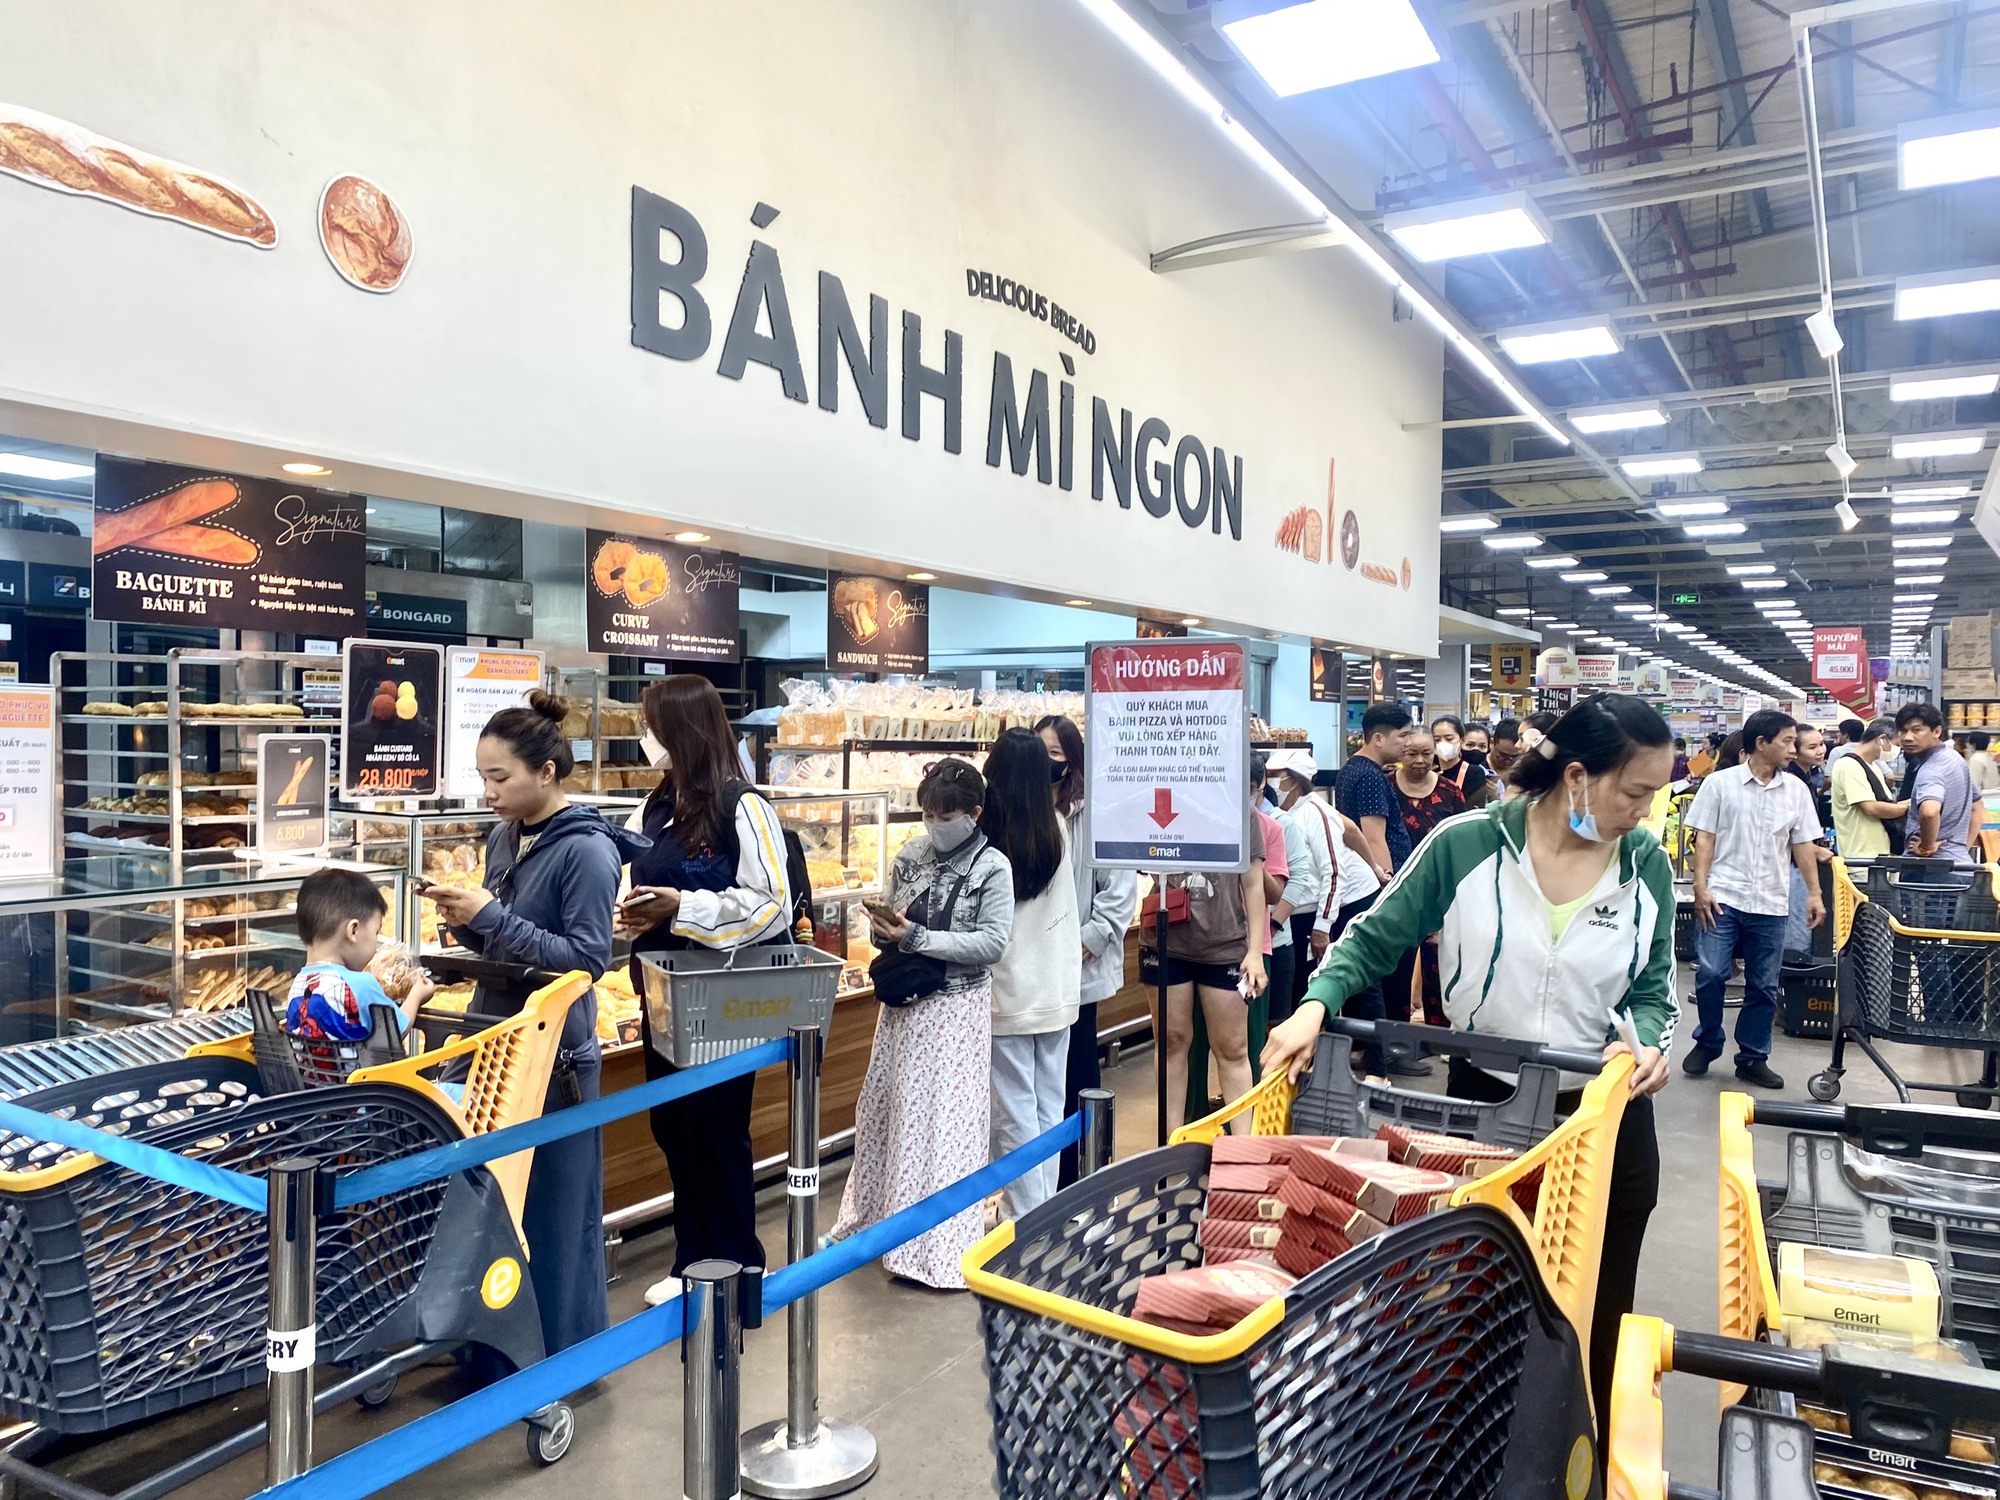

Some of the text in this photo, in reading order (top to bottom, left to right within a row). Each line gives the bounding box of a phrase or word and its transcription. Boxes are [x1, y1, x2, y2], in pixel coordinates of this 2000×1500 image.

[967, 268, 1096, 355] DELICIOUS BREAD
[631, 184, 1243, 542] BÁNH MÌ NGON
[274, 494, 366, 545] Signature
[683, 553, 739, 593] Signature
[115, 570, 234, 599] BAGUETTE
[328, 580, 343, 590] bánh
[142, 595, 207, 614] BÁNH MÌ
[887, 590, 929, 628] Signature
[383, 609, 452, 624] BONGARD
[612, 612, 650, 629] CURVE
[602, 630, 660, 648] CROISSANT
[1816, 632, 1858, 642] KHUYẾN
[386, 656, 405, 666] emart
[455, 655, 476, 663] emart
[837, 652, 878, 665] SANDWICH
[1115, 650, 1226, 678] HƯỚNG DẪN
[1544, 688, 1568, 701] THÍCH
[1126, 699, 1208, 712] QUÝ KHÁCH MUA
[1139, 716, 1167, 726] PIZZA
[1170, 714, 1183, 726] VÀ
[1186, 715, 1227, 726] HOTDOG
[1118, 728, 1217, 741] VUI LÒNG XẾP HÀNG
[1115, 744, 1221, 759] THANH TOÁN TẠI ĐÂY.
[1109, 764, 1122, 773] CÁC
[1123, 766, 1138, 774] LOẠI
[1139, 765, 1157, 773] BÁNH
[1178, 764, 1187, 772] CÓ
[359, 768, 412, 788] 28.800
[1107, 774, 1123, 782] TOÁN
[1125, 776, 1135, 784] TẠI
[1170, 774, 1188, 782] NGÂN
[1190, 774, 1203, 782] BÊN
[276, 825, 305, 842] 6.800
[1148, 846, 1180, 857] emart
[1589, 920, 1619, 930] adidas
[723, 995, 792, 1020] emart
[1834, 1307, 1881, 1326] emart
[1868, 1449, 1917, 1470] emart
